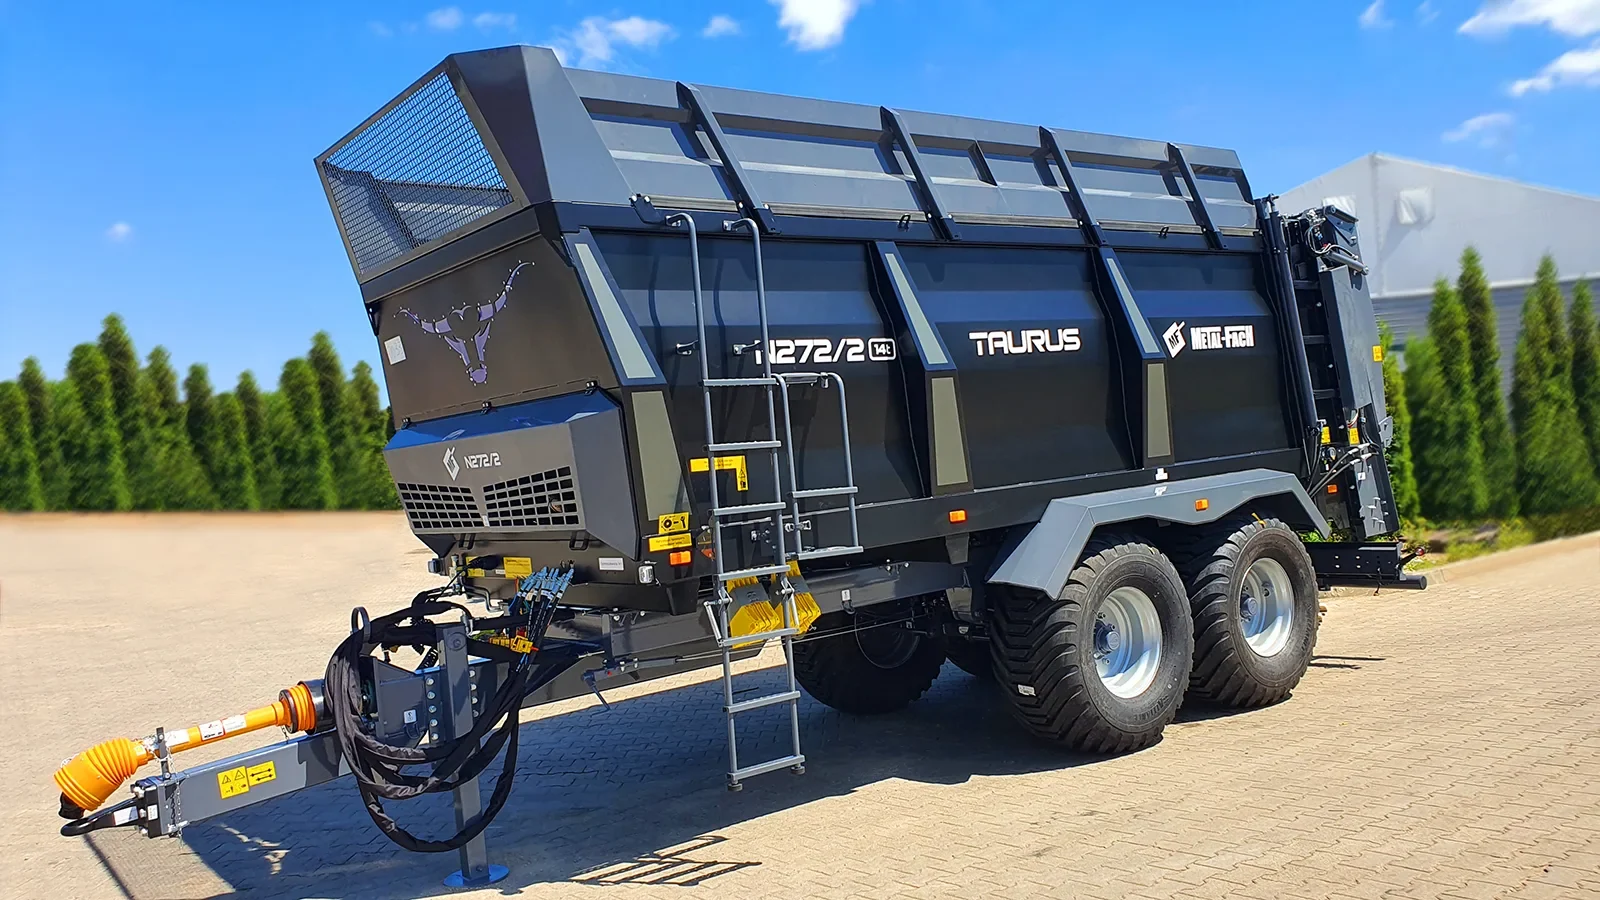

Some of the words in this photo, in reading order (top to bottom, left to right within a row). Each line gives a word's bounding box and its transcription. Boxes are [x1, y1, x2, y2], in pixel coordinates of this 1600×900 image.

[968, 328, 1081, 356] TAURUS
[1190, 325, 1255, 350] METAL-FACH
[754, 338, 865, 365] N272/2
[873, 343, 891, 355] 14t
[463, 452, 502, 469] N272/2
